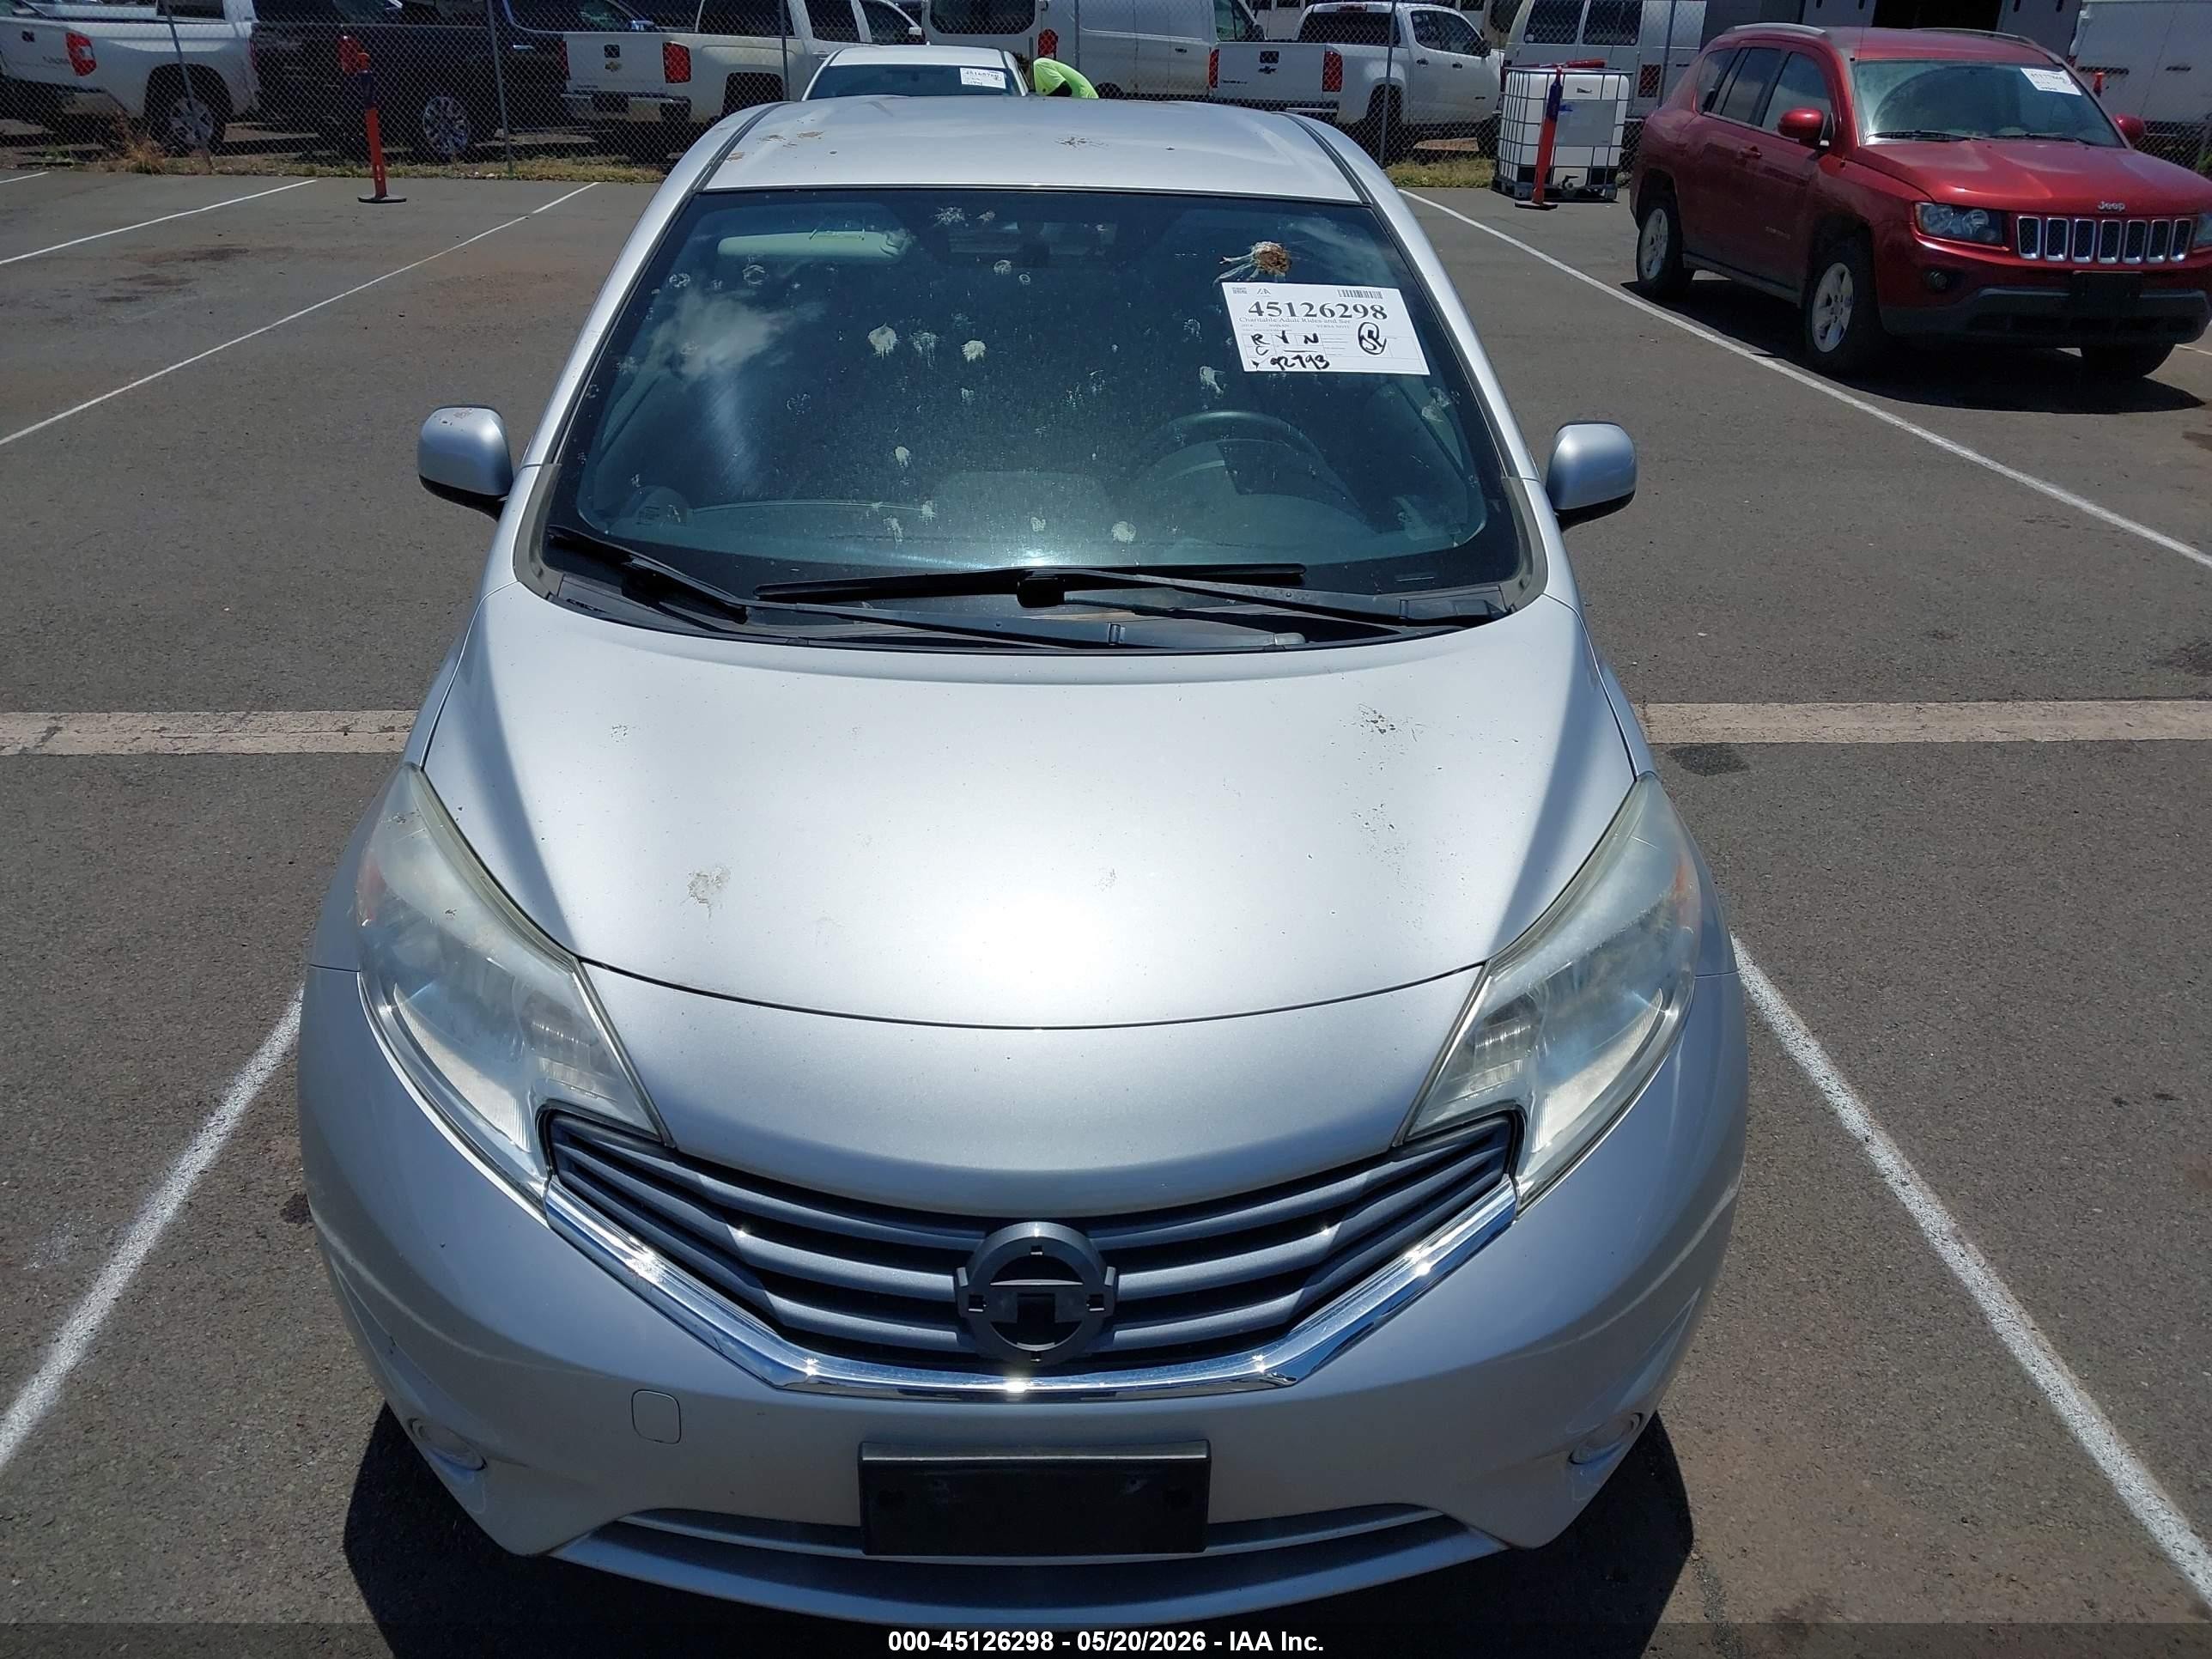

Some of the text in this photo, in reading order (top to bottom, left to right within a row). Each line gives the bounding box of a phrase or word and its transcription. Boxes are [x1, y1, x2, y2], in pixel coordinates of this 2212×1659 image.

[2097, 200, 2126, 212] Jeep
[1248, 301, 1389, 320] 45126298
[1304, 332, 1320, 345] N
